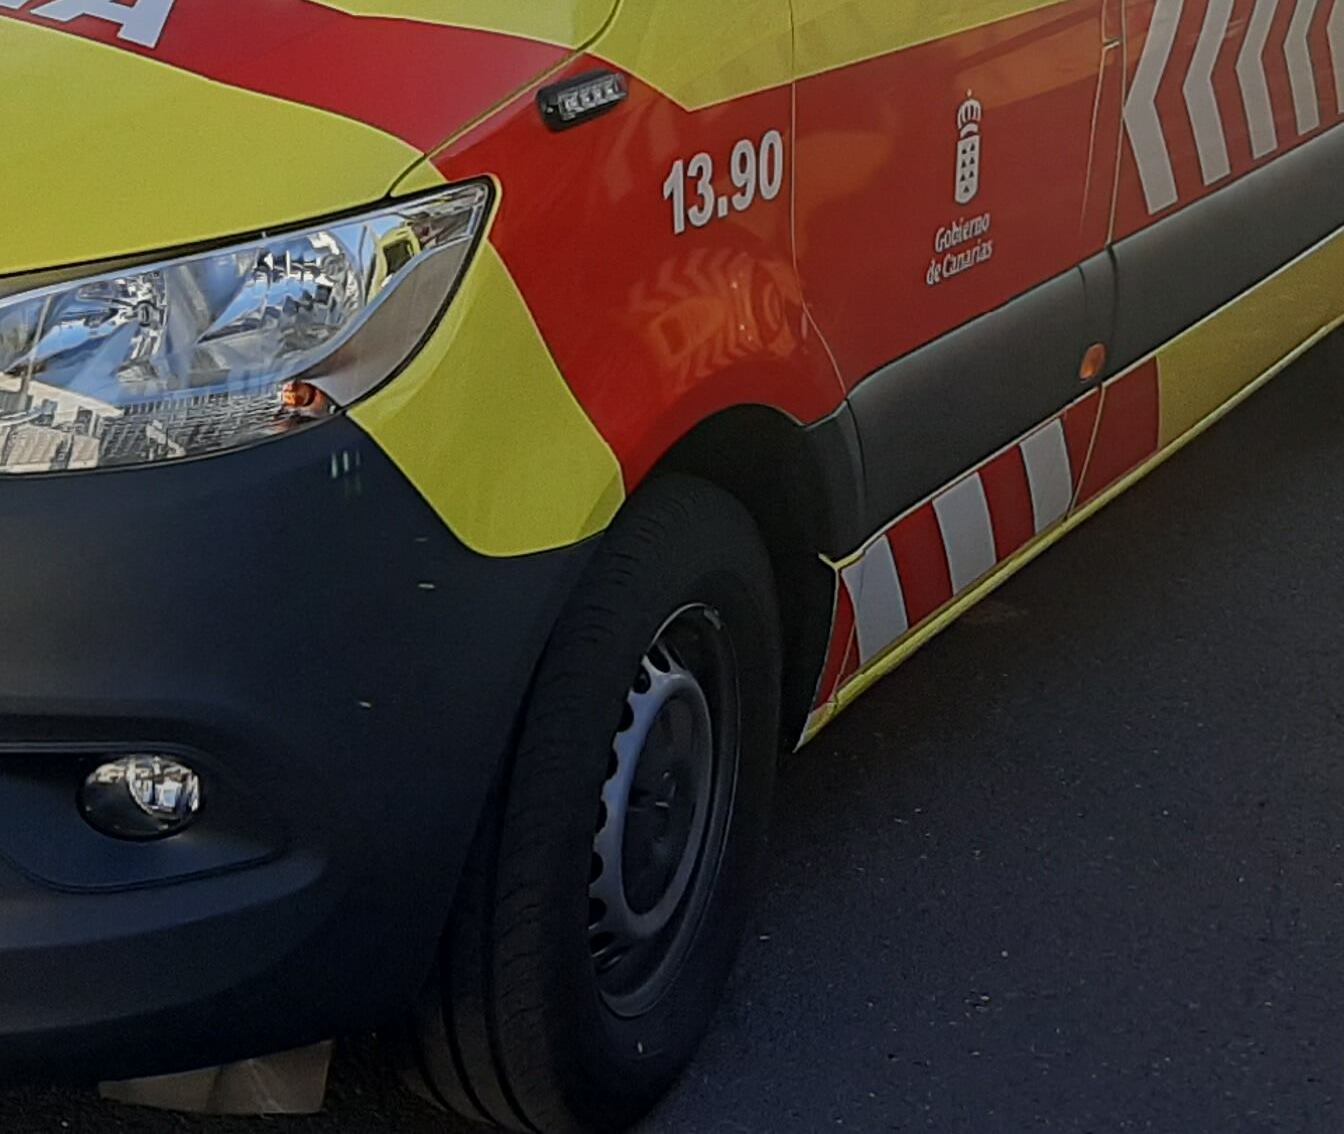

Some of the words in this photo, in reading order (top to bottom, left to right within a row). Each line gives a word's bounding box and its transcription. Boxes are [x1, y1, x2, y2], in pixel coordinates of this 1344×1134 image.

[662, 129, 784, 235] 13.90
[934, 212, 991, 253] Gobierno
[925, 260, 942, 286] de
[942, 238, 993, 279] Canarias
